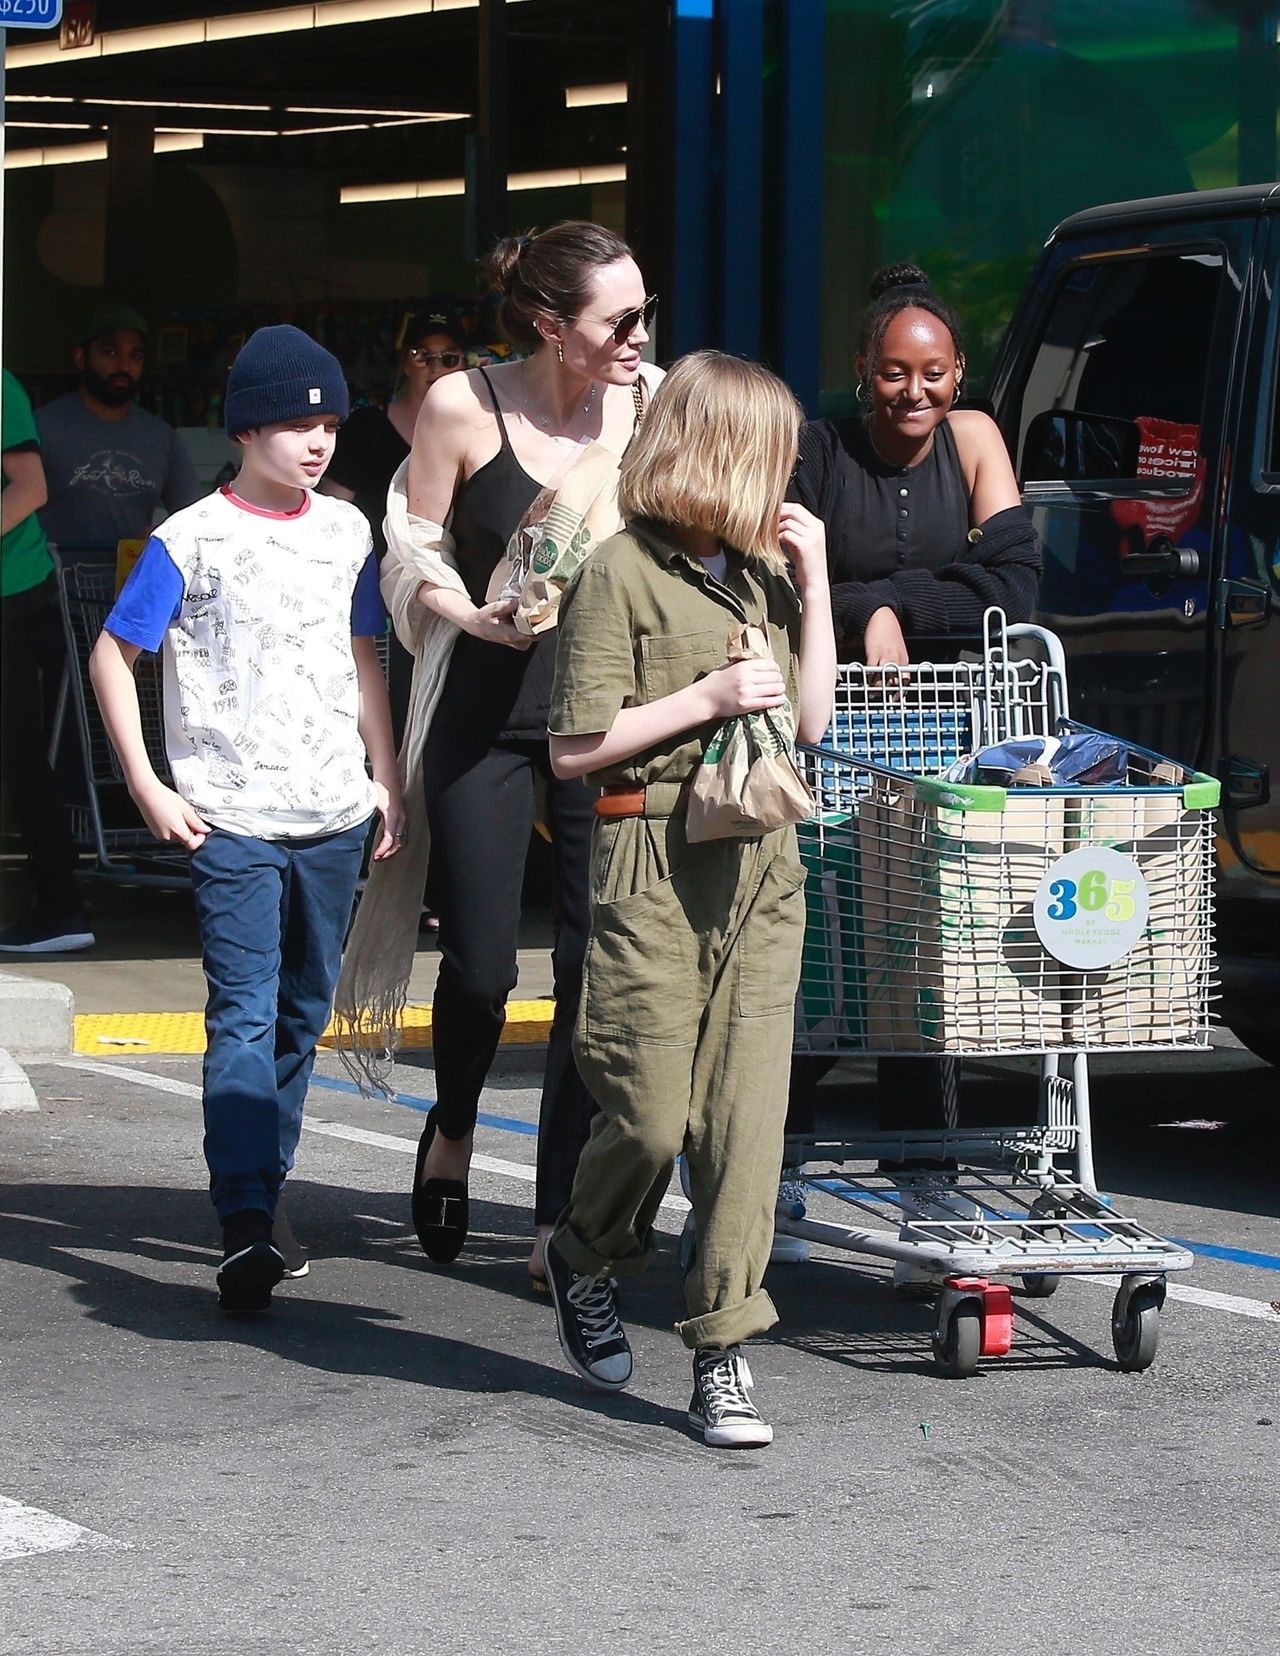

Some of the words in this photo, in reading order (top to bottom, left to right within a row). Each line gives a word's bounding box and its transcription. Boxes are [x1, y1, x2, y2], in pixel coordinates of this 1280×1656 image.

[213, 696, 238, 715] 1978
[253, 760, 289, 772] Versace
[1046, 870, 1137, 922] 365
